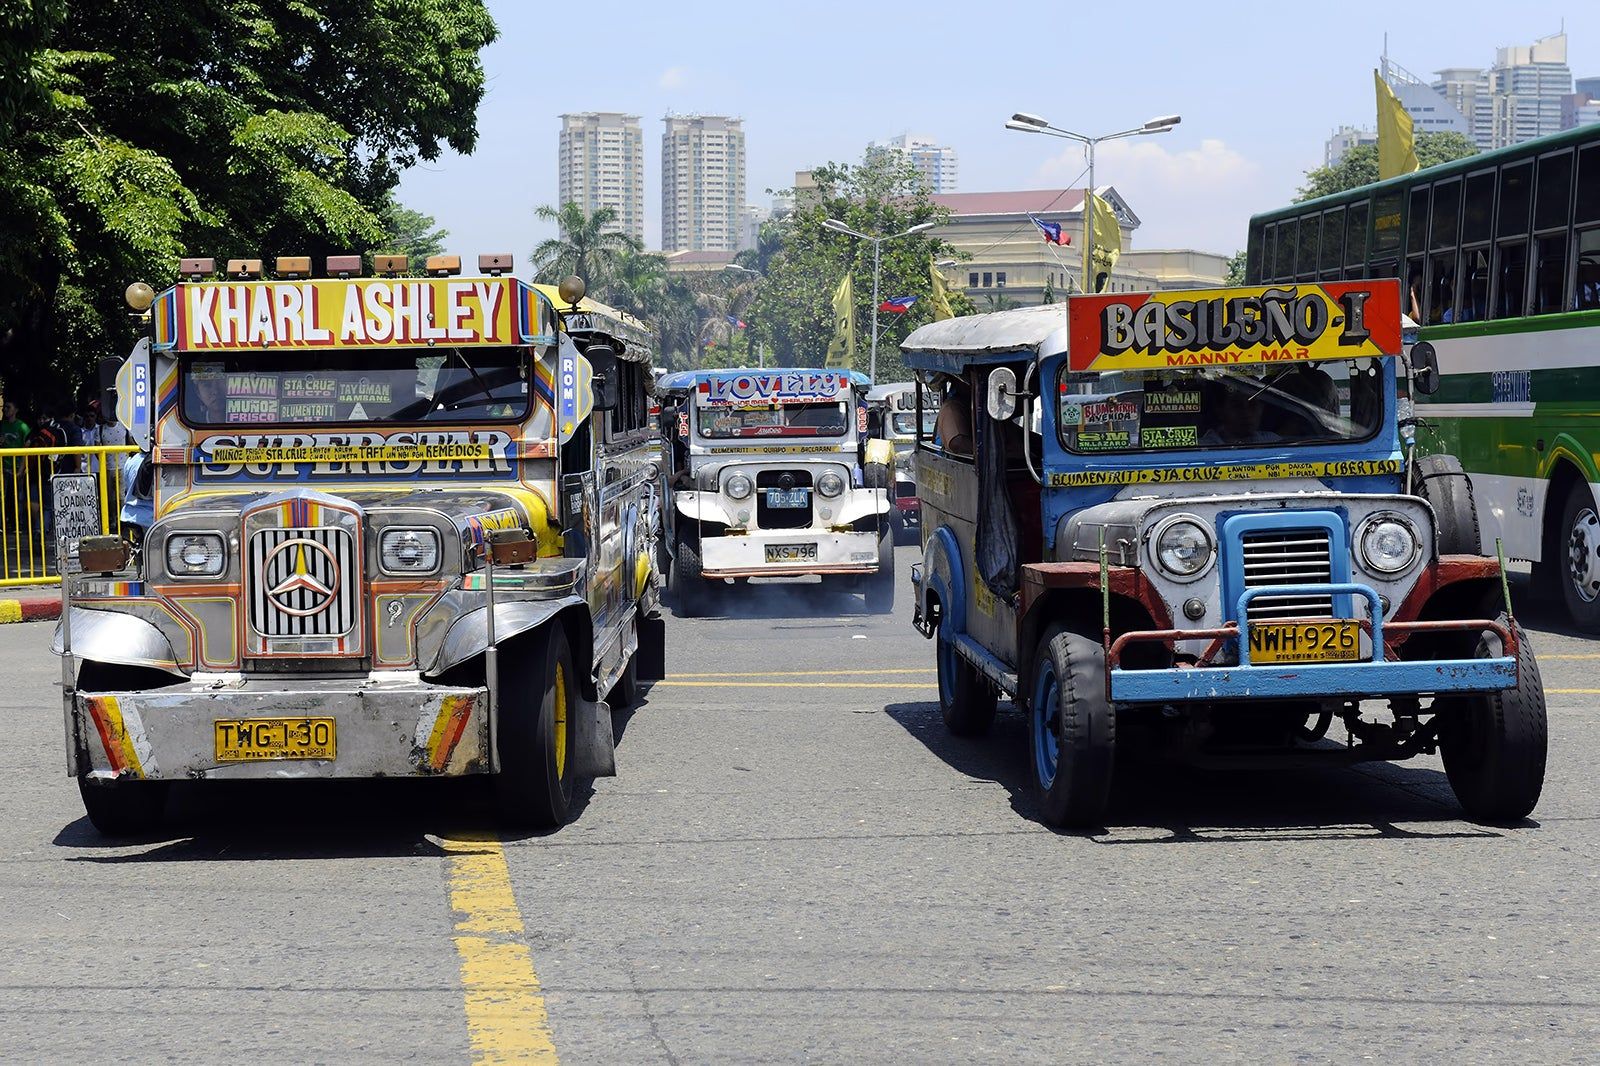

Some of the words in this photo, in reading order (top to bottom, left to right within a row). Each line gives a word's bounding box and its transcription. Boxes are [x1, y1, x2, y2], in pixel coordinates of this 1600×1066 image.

[192, 284, 333, 344] KHARL
[341, 281, 502, 343] ASHLEY
[1166, 351, 1244, 366] MANNY
[1261, 347, 1310, 361] MAR
[227, 376, 277, 396] MAYON
[706, 372, 840, 402] LOVELY
[228, 400, 278, 413] MUÑOZ
[282, 405, 334, 417] BLUMENTRITT
[229, 413, 276, 422] FRISCO
[1168, 429, 1196, 439] CRUZ
[200, 431, 513, 476] SUPERSTAR
[359, 446, 385, 459] TAFT
[426, 444, 482, 458] REMEDIOS
[60, 494, 92, 508] LOADING
[70, 511, 86, 522] AND
[57, 525, 99, 539] UNLOADING
[767, 548, 789, 558] NXS
[793, 547, 815, 558] 796
